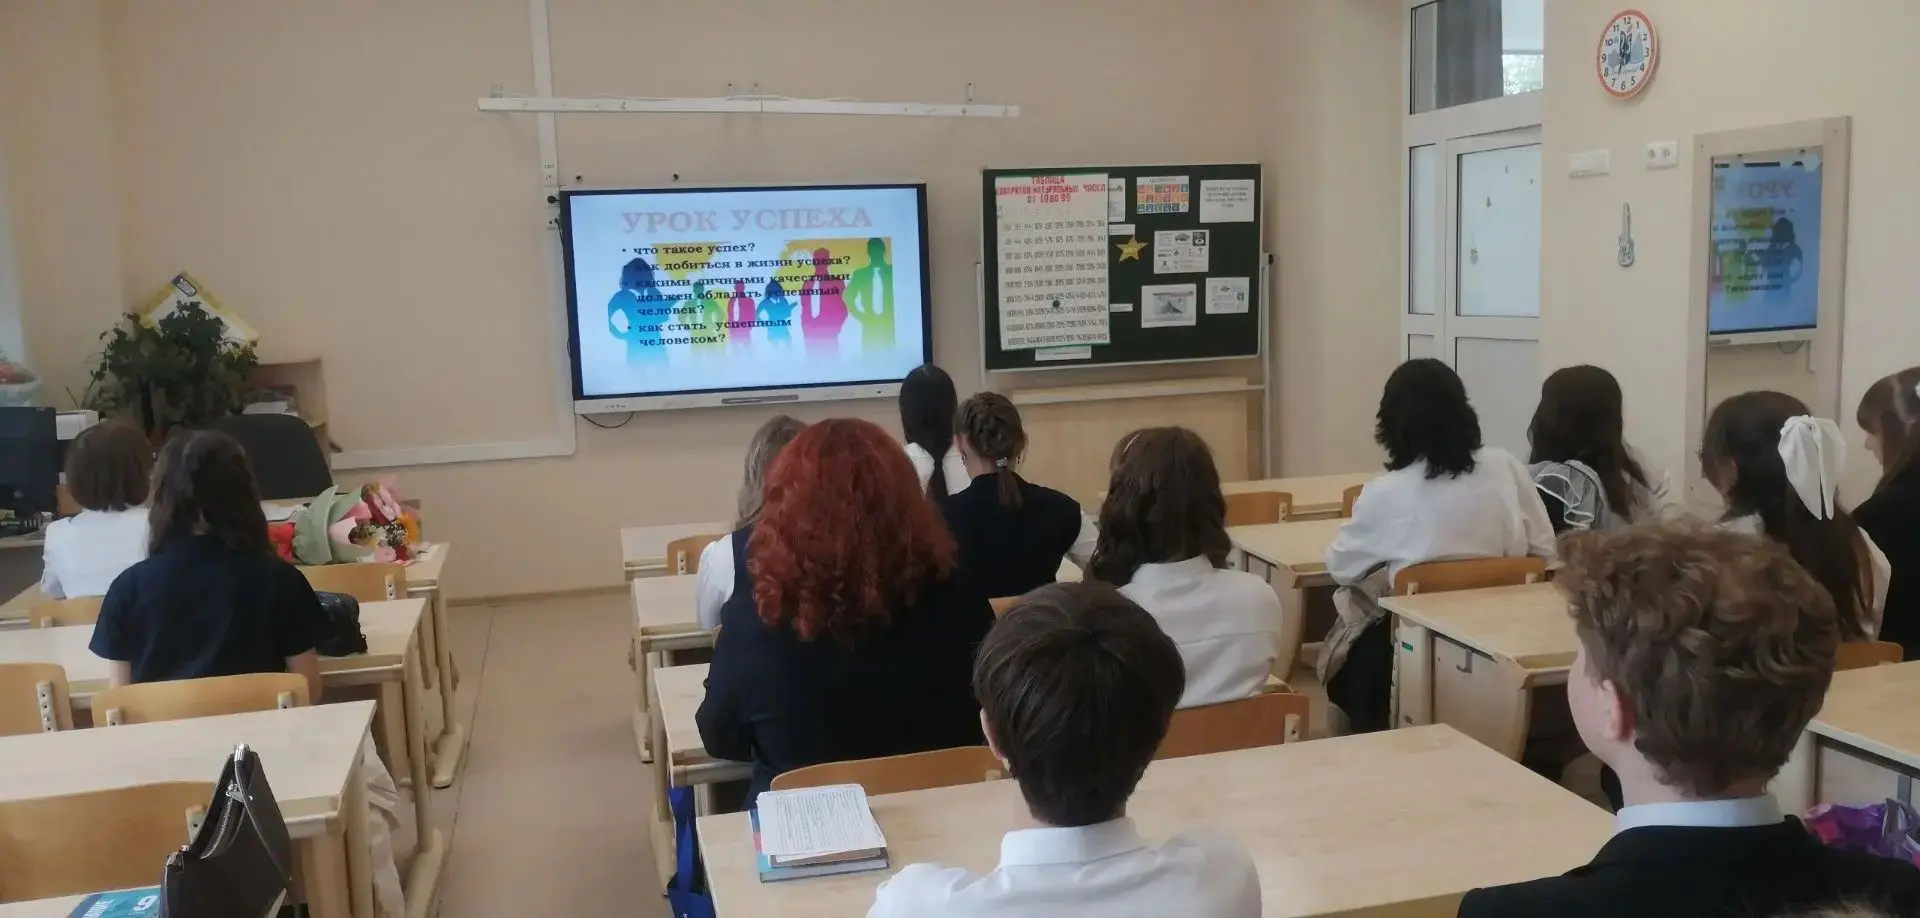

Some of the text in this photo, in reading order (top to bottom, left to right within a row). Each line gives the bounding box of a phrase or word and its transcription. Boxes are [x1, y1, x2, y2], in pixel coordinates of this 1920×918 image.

[1636, 21, 1639, 29] 1
[1642, 33, 1648, 41] 2
[1645, 48, 1649, 57] 3
[1602, 54, 1607, 63] 9
[1640, 63, 1645, 71] 4
[1604, 68, 1609, 77] 8
[1612, 78, 1616, 87] 7
[1630, 76, 1636, 85] 5
[1621, 81, 1626, 90] 6
[621, 207, 872, 234] УРОК УСПЕХА
[633, 242, 755, 255] что такое успех?
[664, 261, 730, 271] добиться
[747, 260, 792, 268] жизни
[796, 256, 851, 268] успеха?
[769, 274, 851, 284] качествами
[636, 293, 692, 303] должен
[697, 290, 762, 299] обладать
[637, 305, 705, 316] человек?
[638, 318, 793, 333] как стать успешным
[639, 334, 727, 347] человеком?
[134, 895, 159, 911] 9
